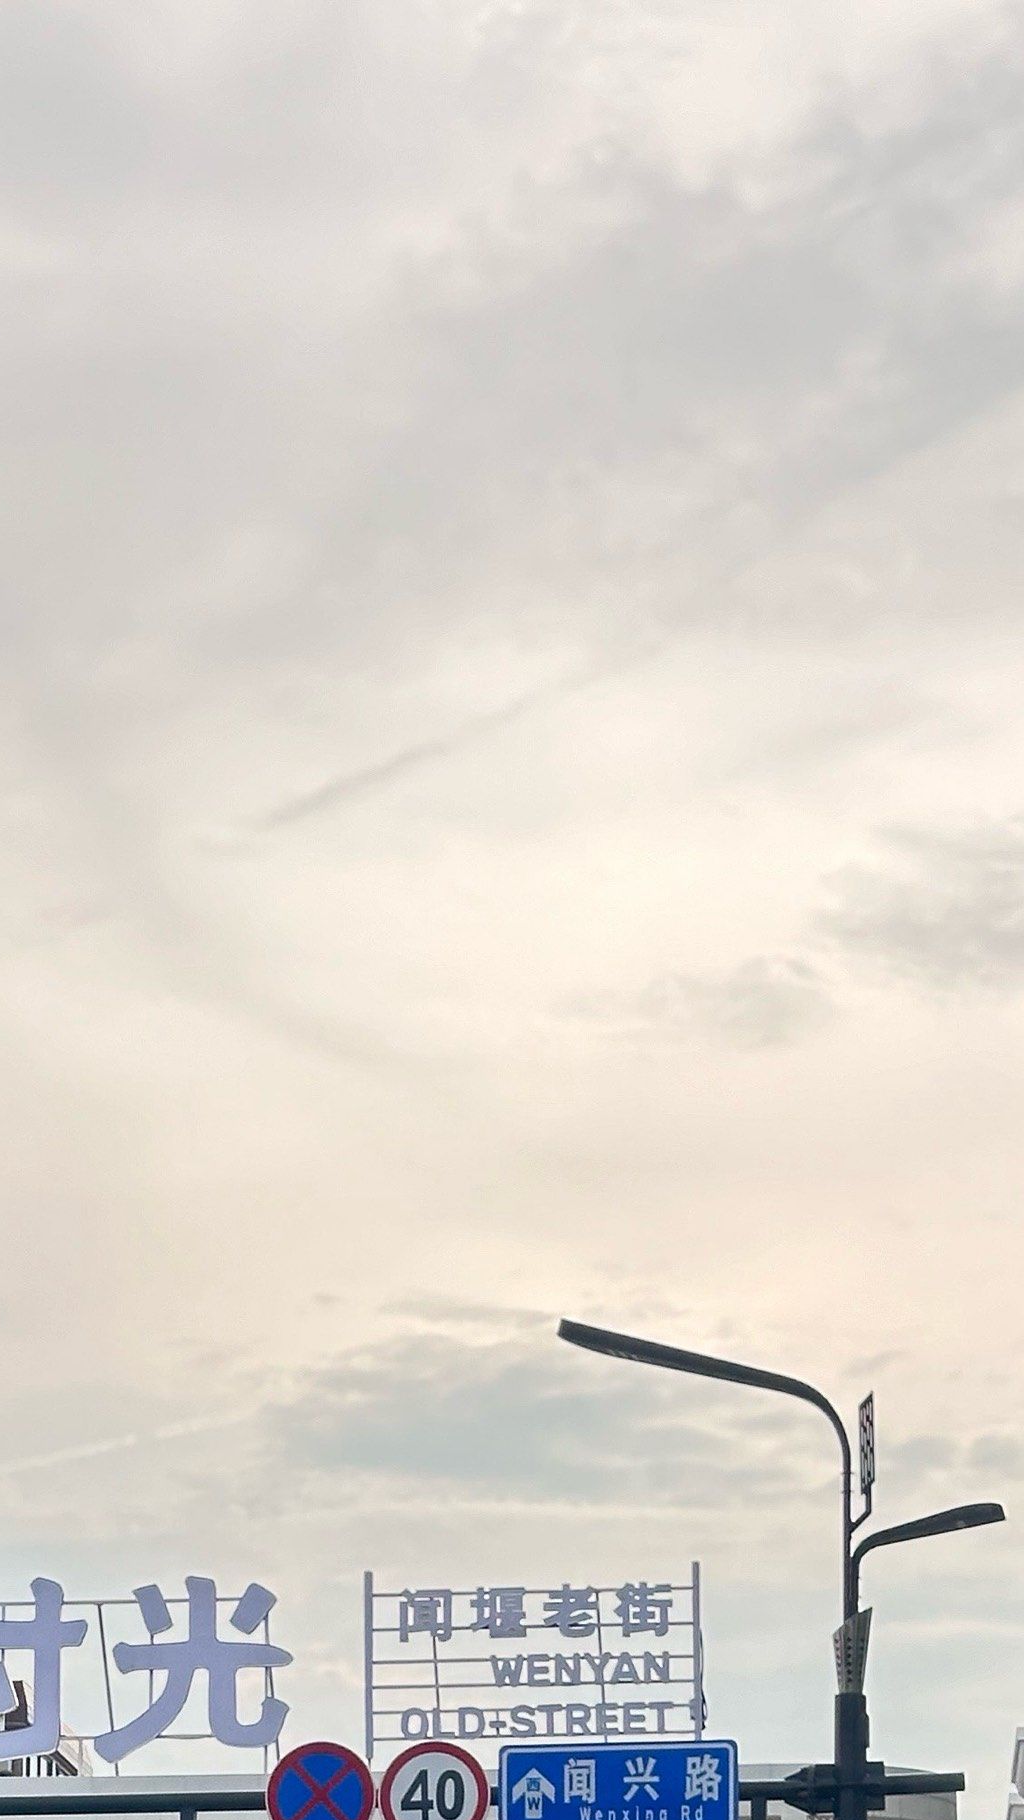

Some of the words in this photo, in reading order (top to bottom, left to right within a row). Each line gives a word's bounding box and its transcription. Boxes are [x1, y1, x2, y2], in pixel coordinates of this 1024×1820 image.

[399, 1582, 673, 1642] 闻堰老街
[490, 1651, 670, 1687] WENYAN
[527, 1777, 540, 1791] 西
[563, 1754, 722, 1804] 闻兴路
[527, 1796, 541, 1811] W
